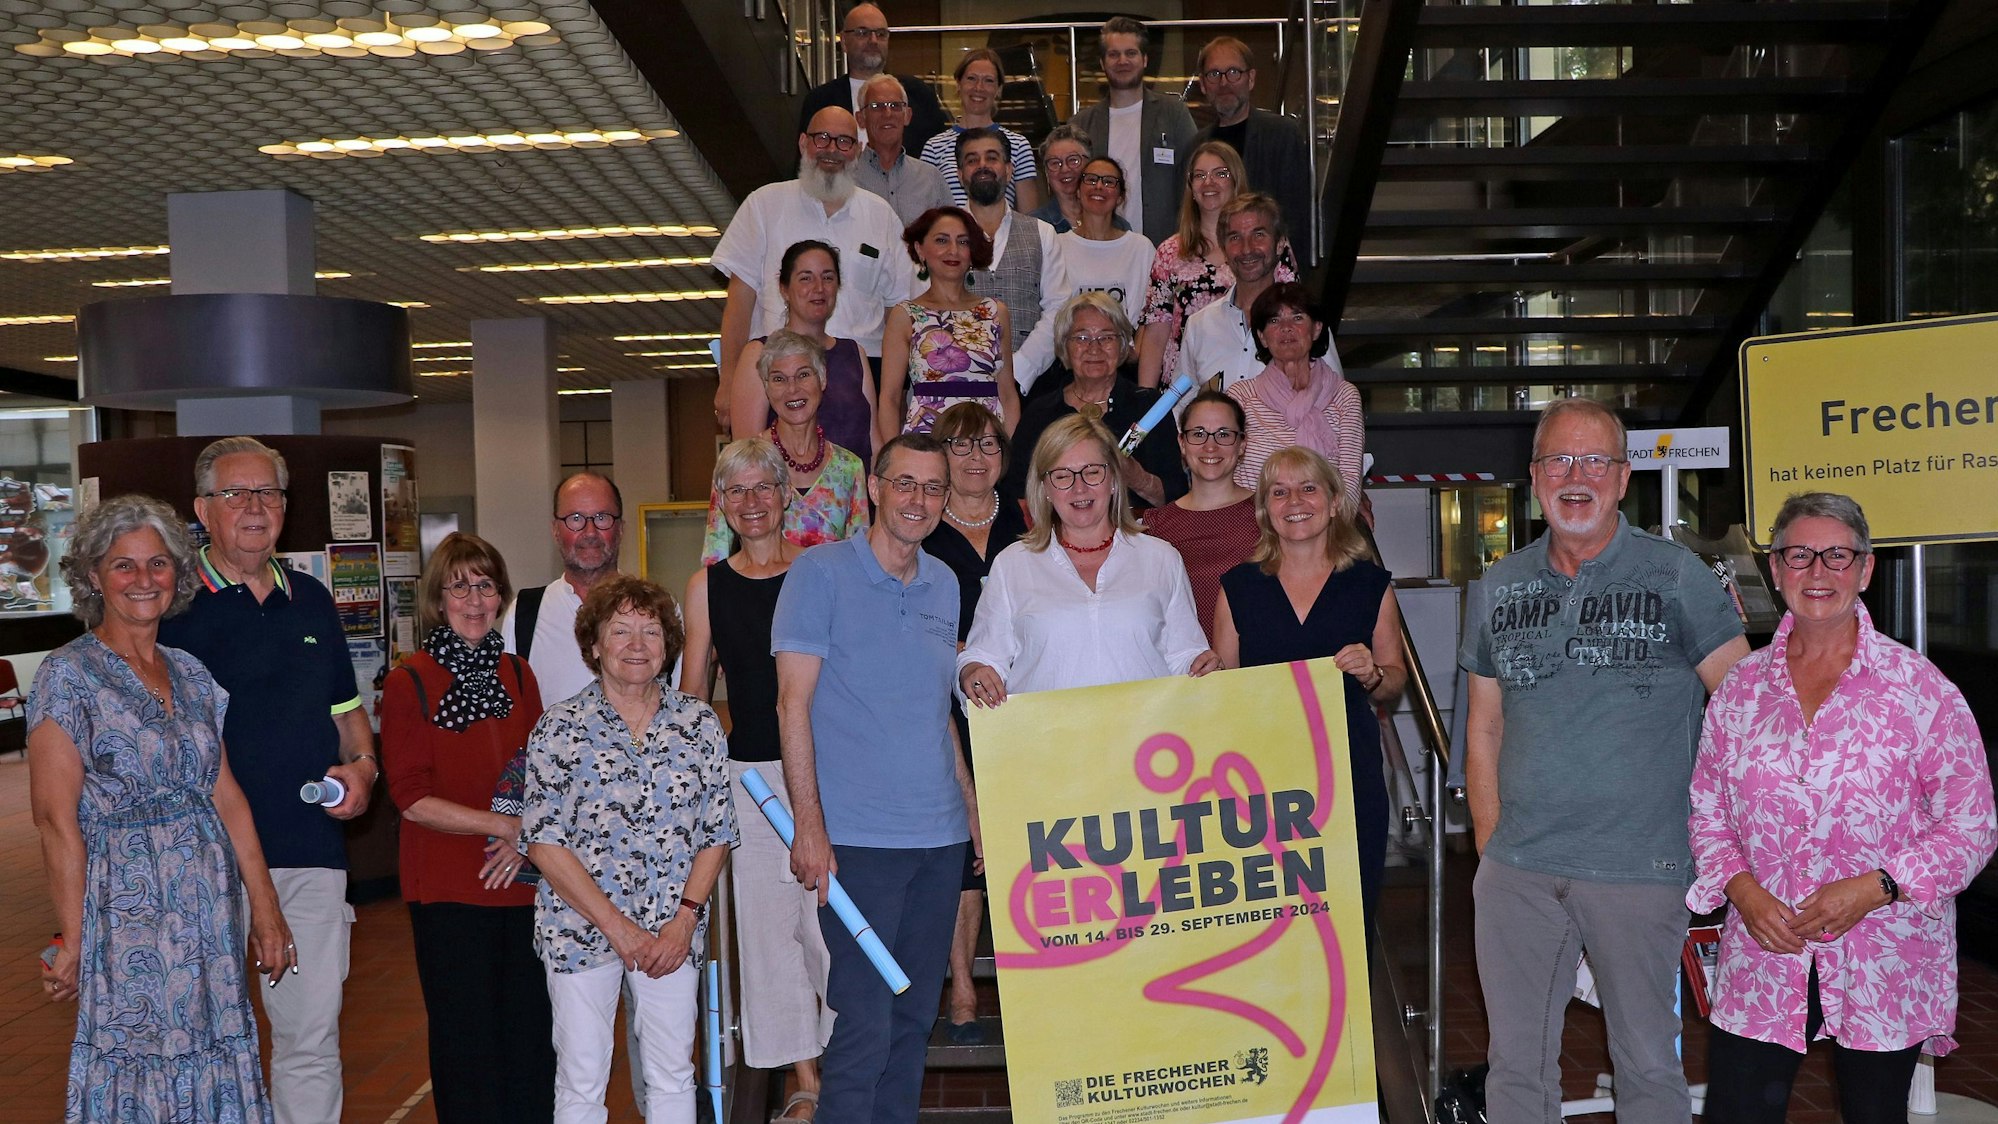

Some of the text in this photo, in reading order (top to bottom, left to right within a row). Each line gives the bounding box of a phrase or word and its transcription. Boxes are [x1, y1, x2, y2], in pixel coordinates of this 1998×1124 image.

[1626, 447, 1720, 459] TADT FRECHEN
[1769, 453, 1998, 482] hat keinen Platz für Ras
[1491, 599, 1560, 635] CAMP
[1579, 591, 1662, 625] DAVID
[1494, 629, 1552, 646] TROPICAL
[1027, 789, 1322, 873] KULTUR
[1032, 846, 1327, 928] ERLEBEN
[1040, 901, 1330, 948] VOM 14. BIS 29. SEPTEMBER 2024
[1086, 1059, 1230, 1089] DIE FRECHENER
[1087, 1073, 1236, 1104] KULTURWOCHEN
[1069, 1112, 1094, 1120] Programm
[1136, 1102, 1170, 1110] Kulturwochen
[1199, 1095, 1232, 1103] Informationen
